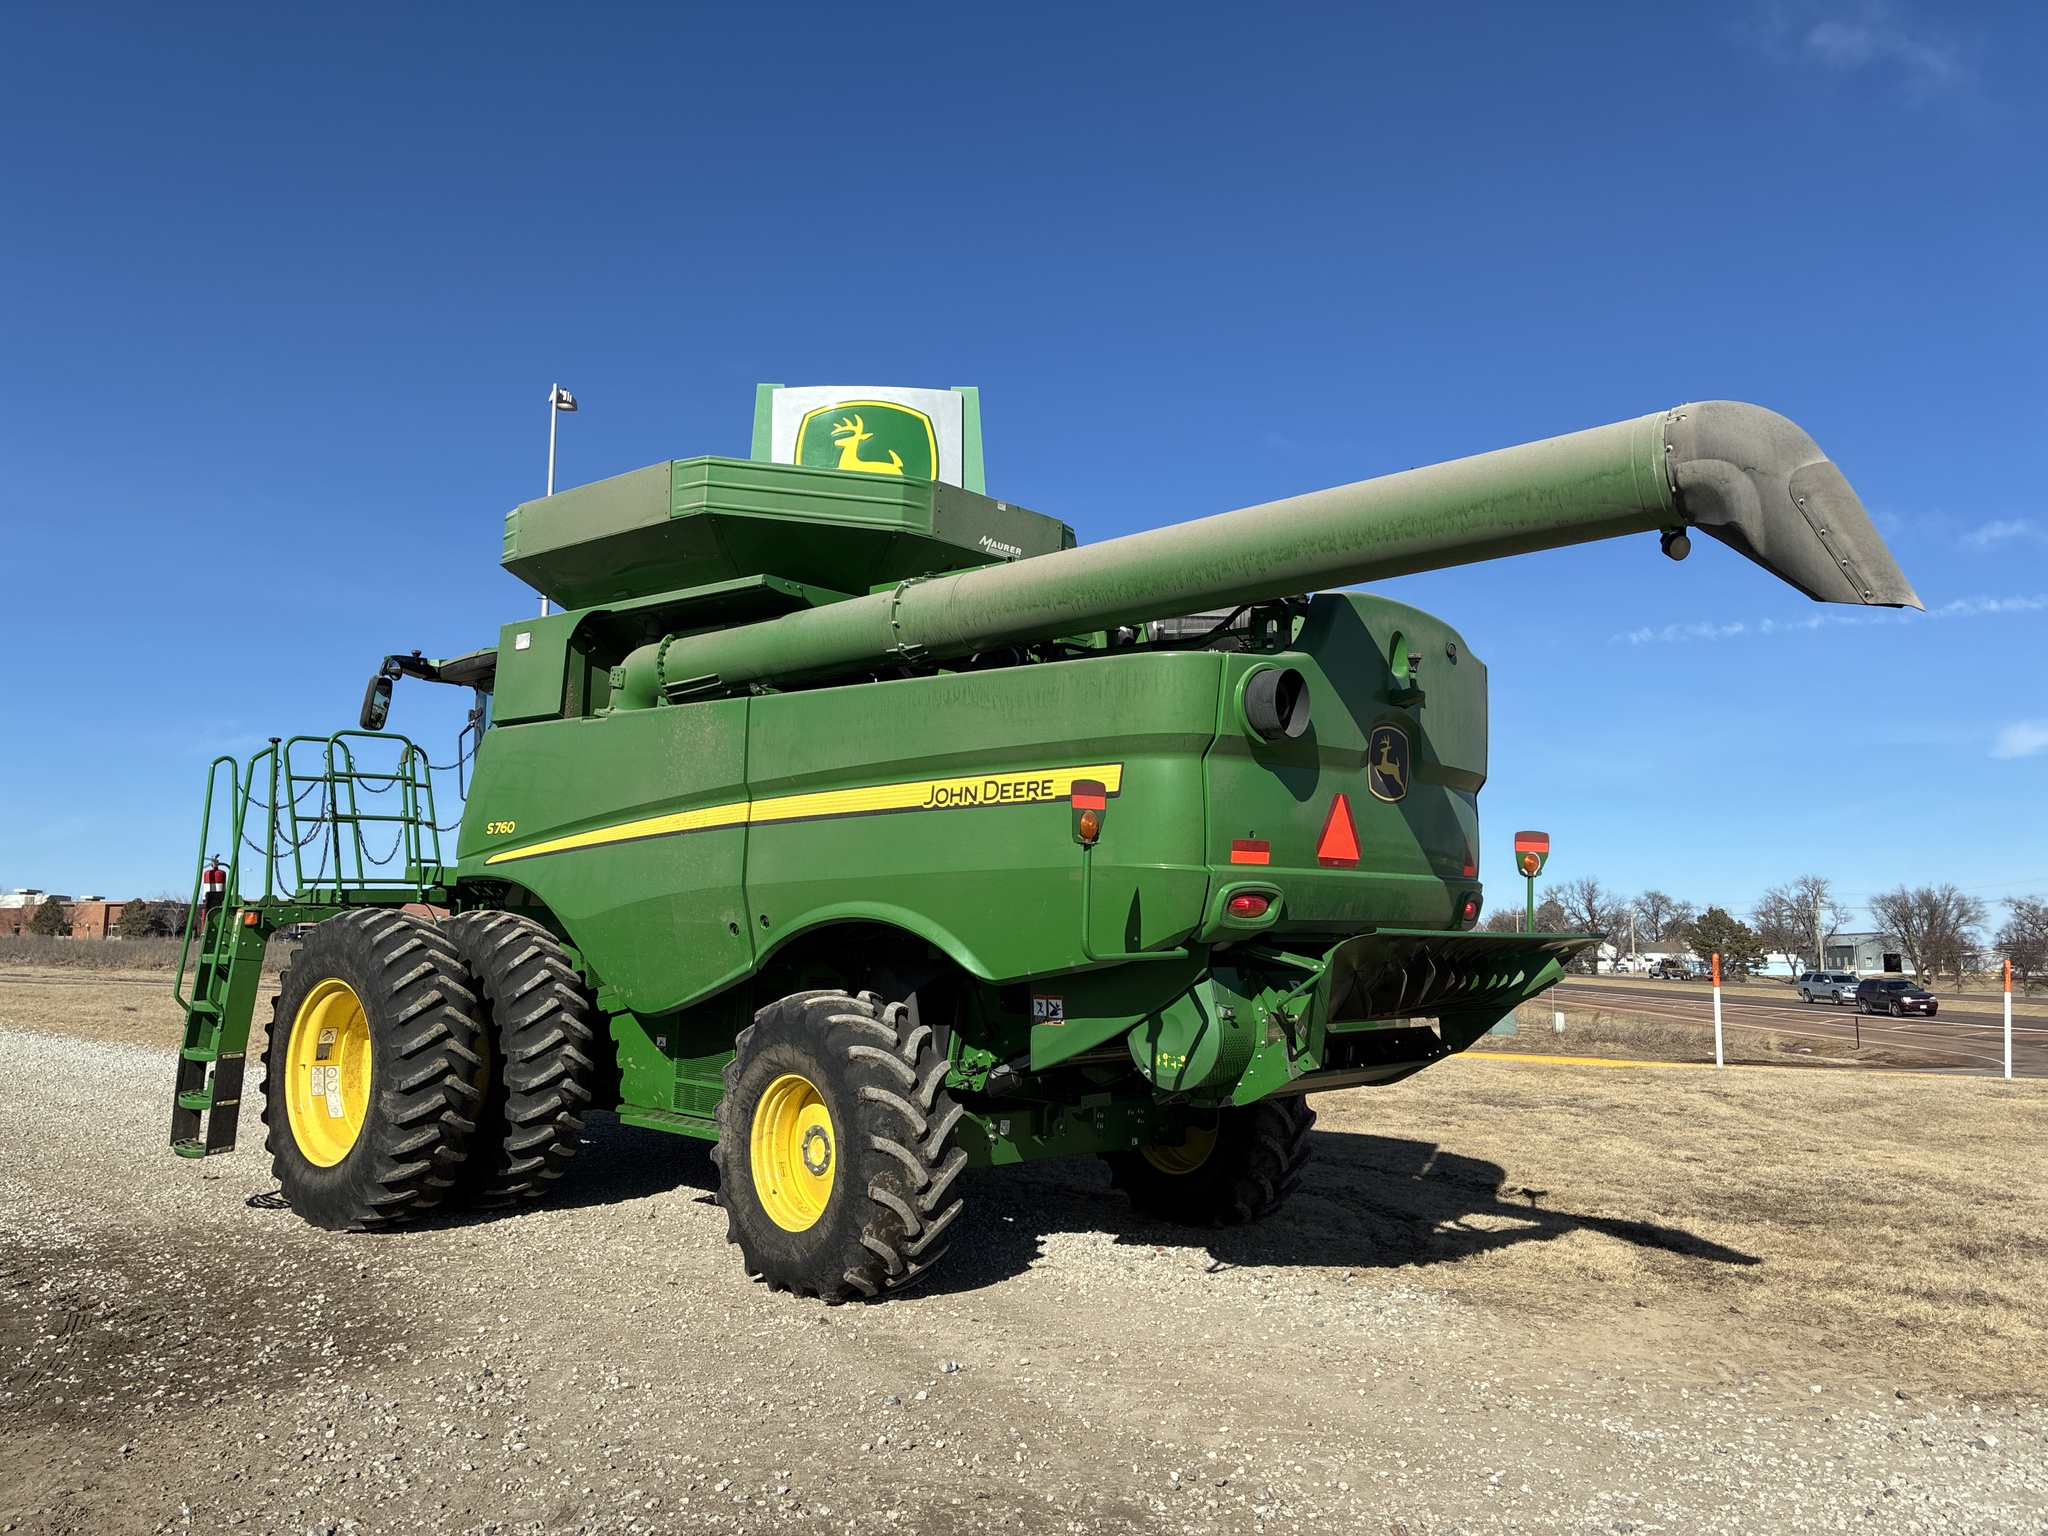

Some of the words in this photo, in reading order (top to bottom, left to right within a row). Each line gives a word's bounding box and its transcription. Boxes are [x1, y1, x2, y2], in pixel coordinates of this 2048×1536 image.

[979, 535, 1022, 555] MAURER
[923, 785, 978, 806] JOHN
[983, 779, 1054, 801] DEERE
[486, 820, 516, 835] S760
